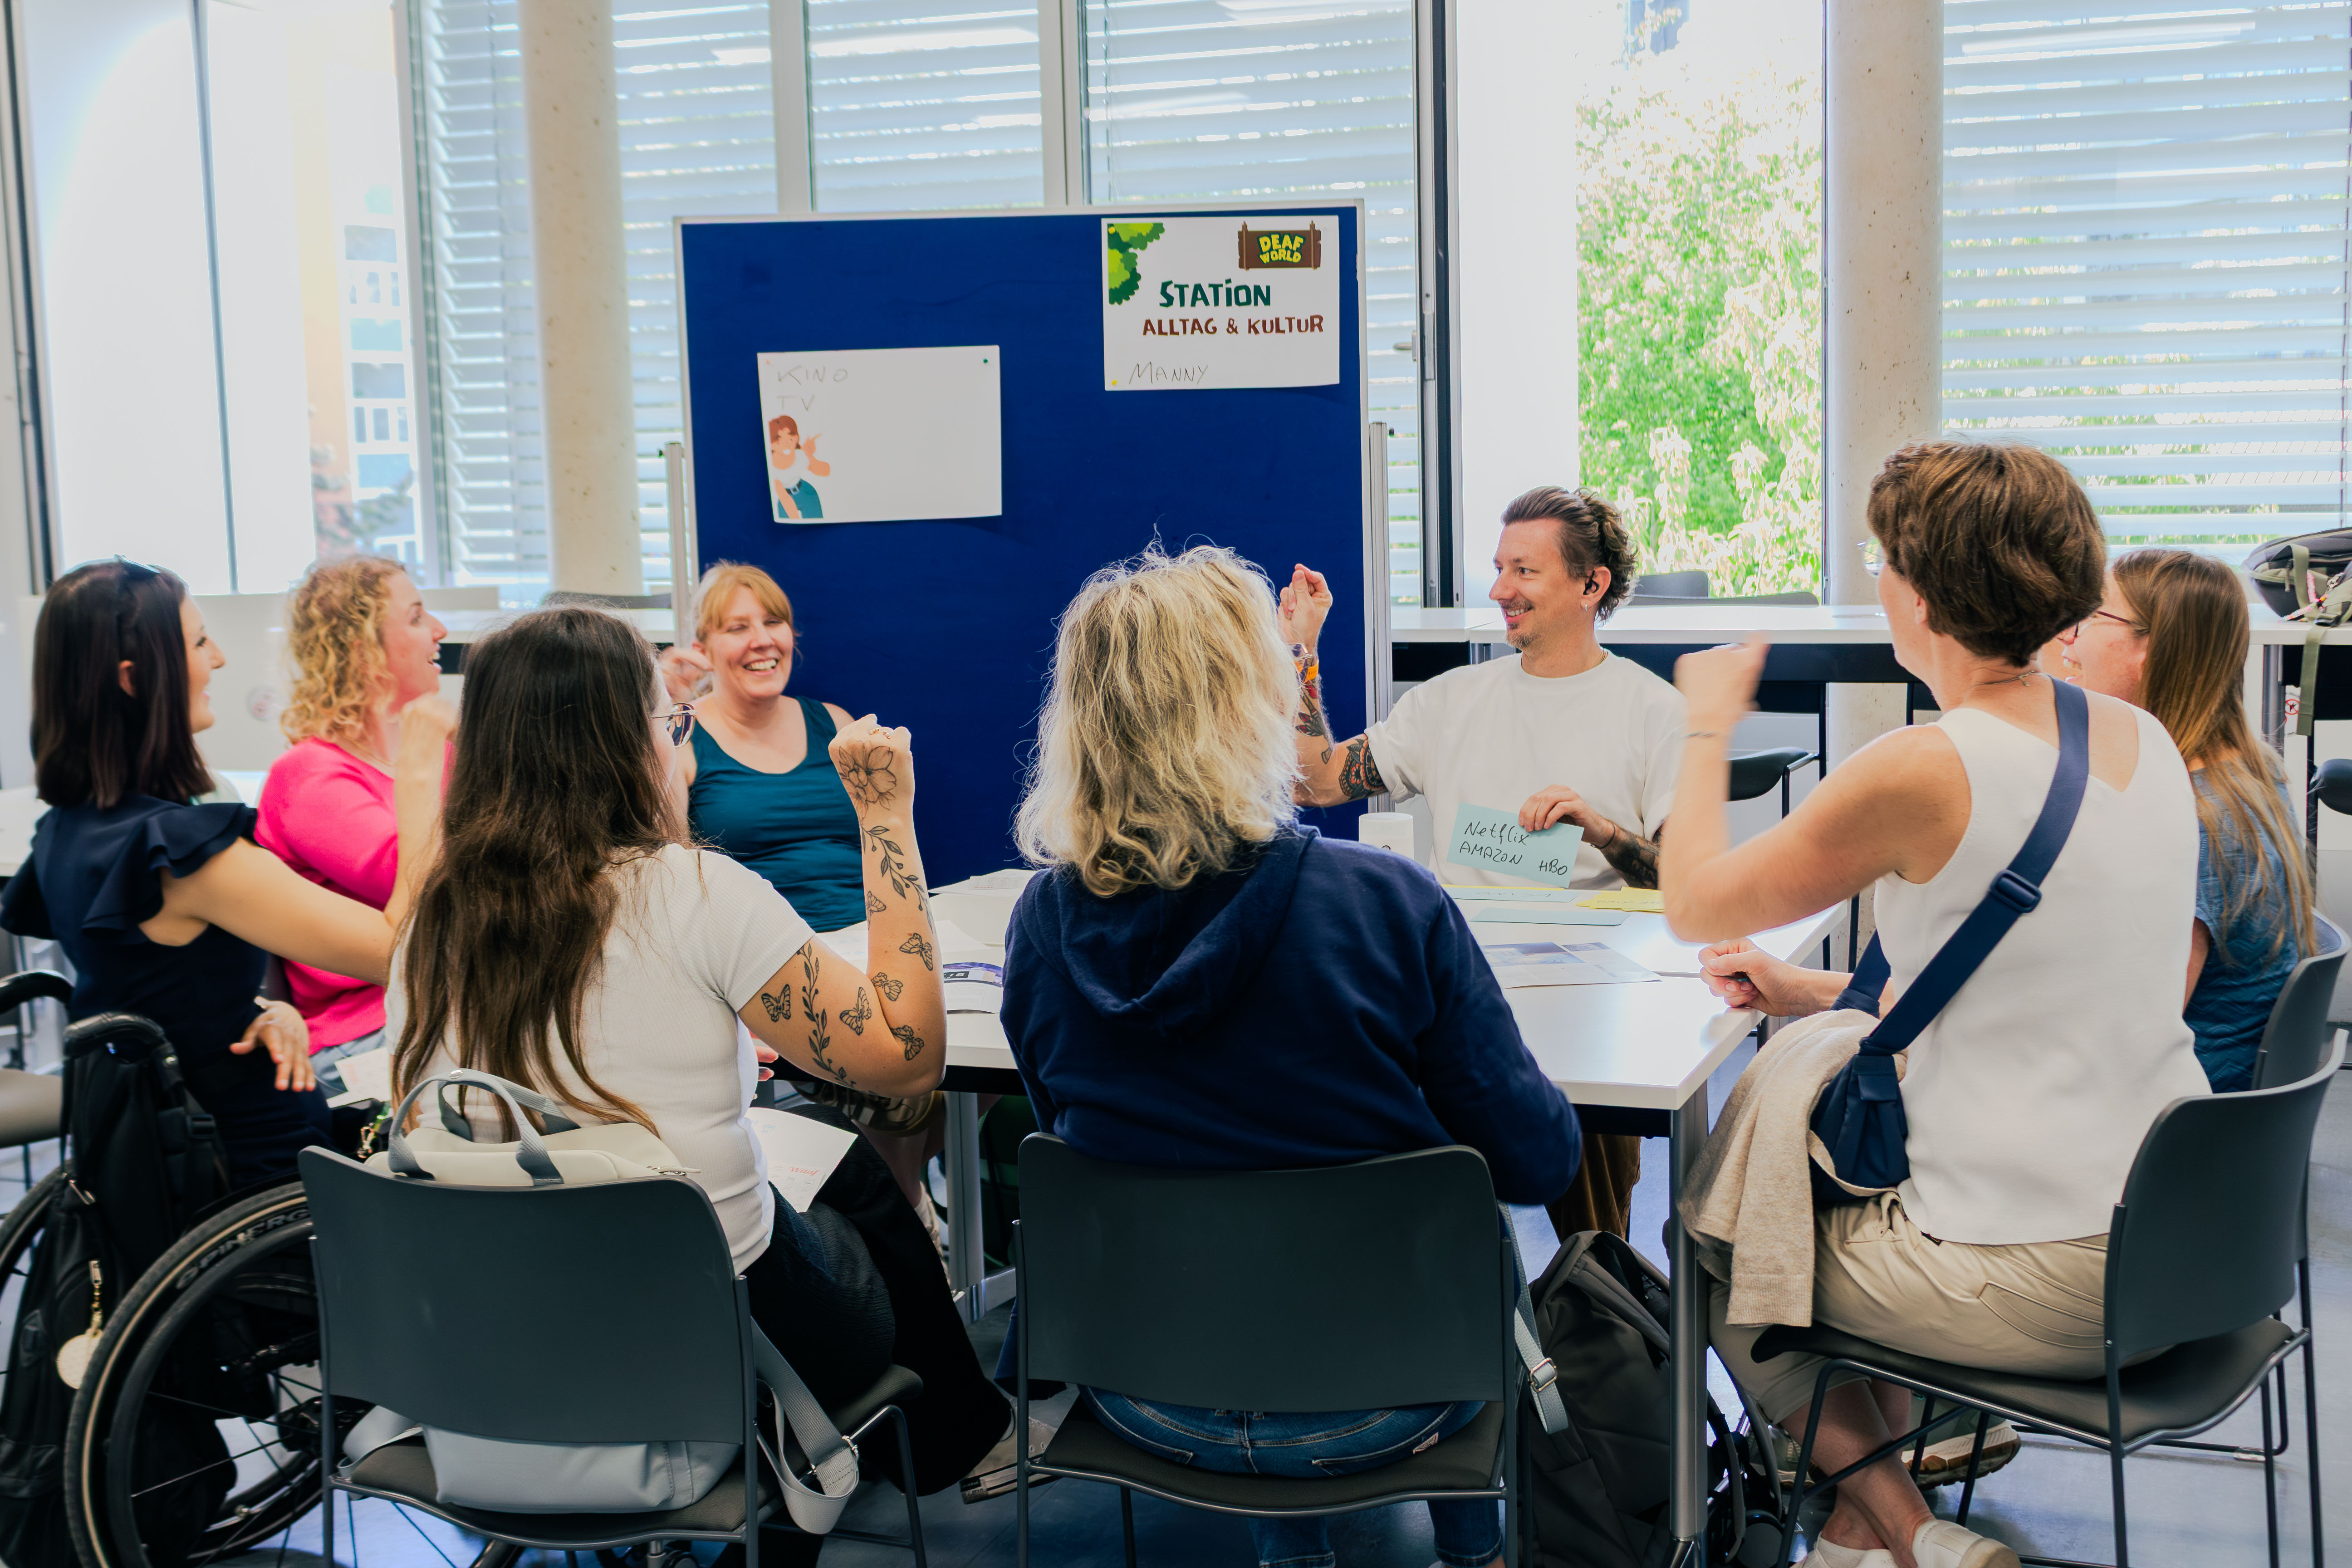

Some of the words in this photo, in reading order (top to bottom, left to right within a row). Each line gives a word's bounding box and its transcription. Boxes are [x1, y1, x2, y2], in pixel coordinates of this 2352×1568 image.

[1259, 234, 1303, 252] DEAF
[1260, 249, 1302, 264] WORLD
[1142, 318, 1217, 336] ALLTAG
[1226, 318, 1239, 334] &
[1248, 315, 1324, 335] KULTUR
[778, 365, 848, 385] KINO
[1129, 362, 1208, 384] MANNY
[777, 395, 815, 412] TV
[1464, 821, 1529, 846] Netflix
[1459, 841, 1523, 864] AMAZON
[1539, 859, 1568, 875] HBO
